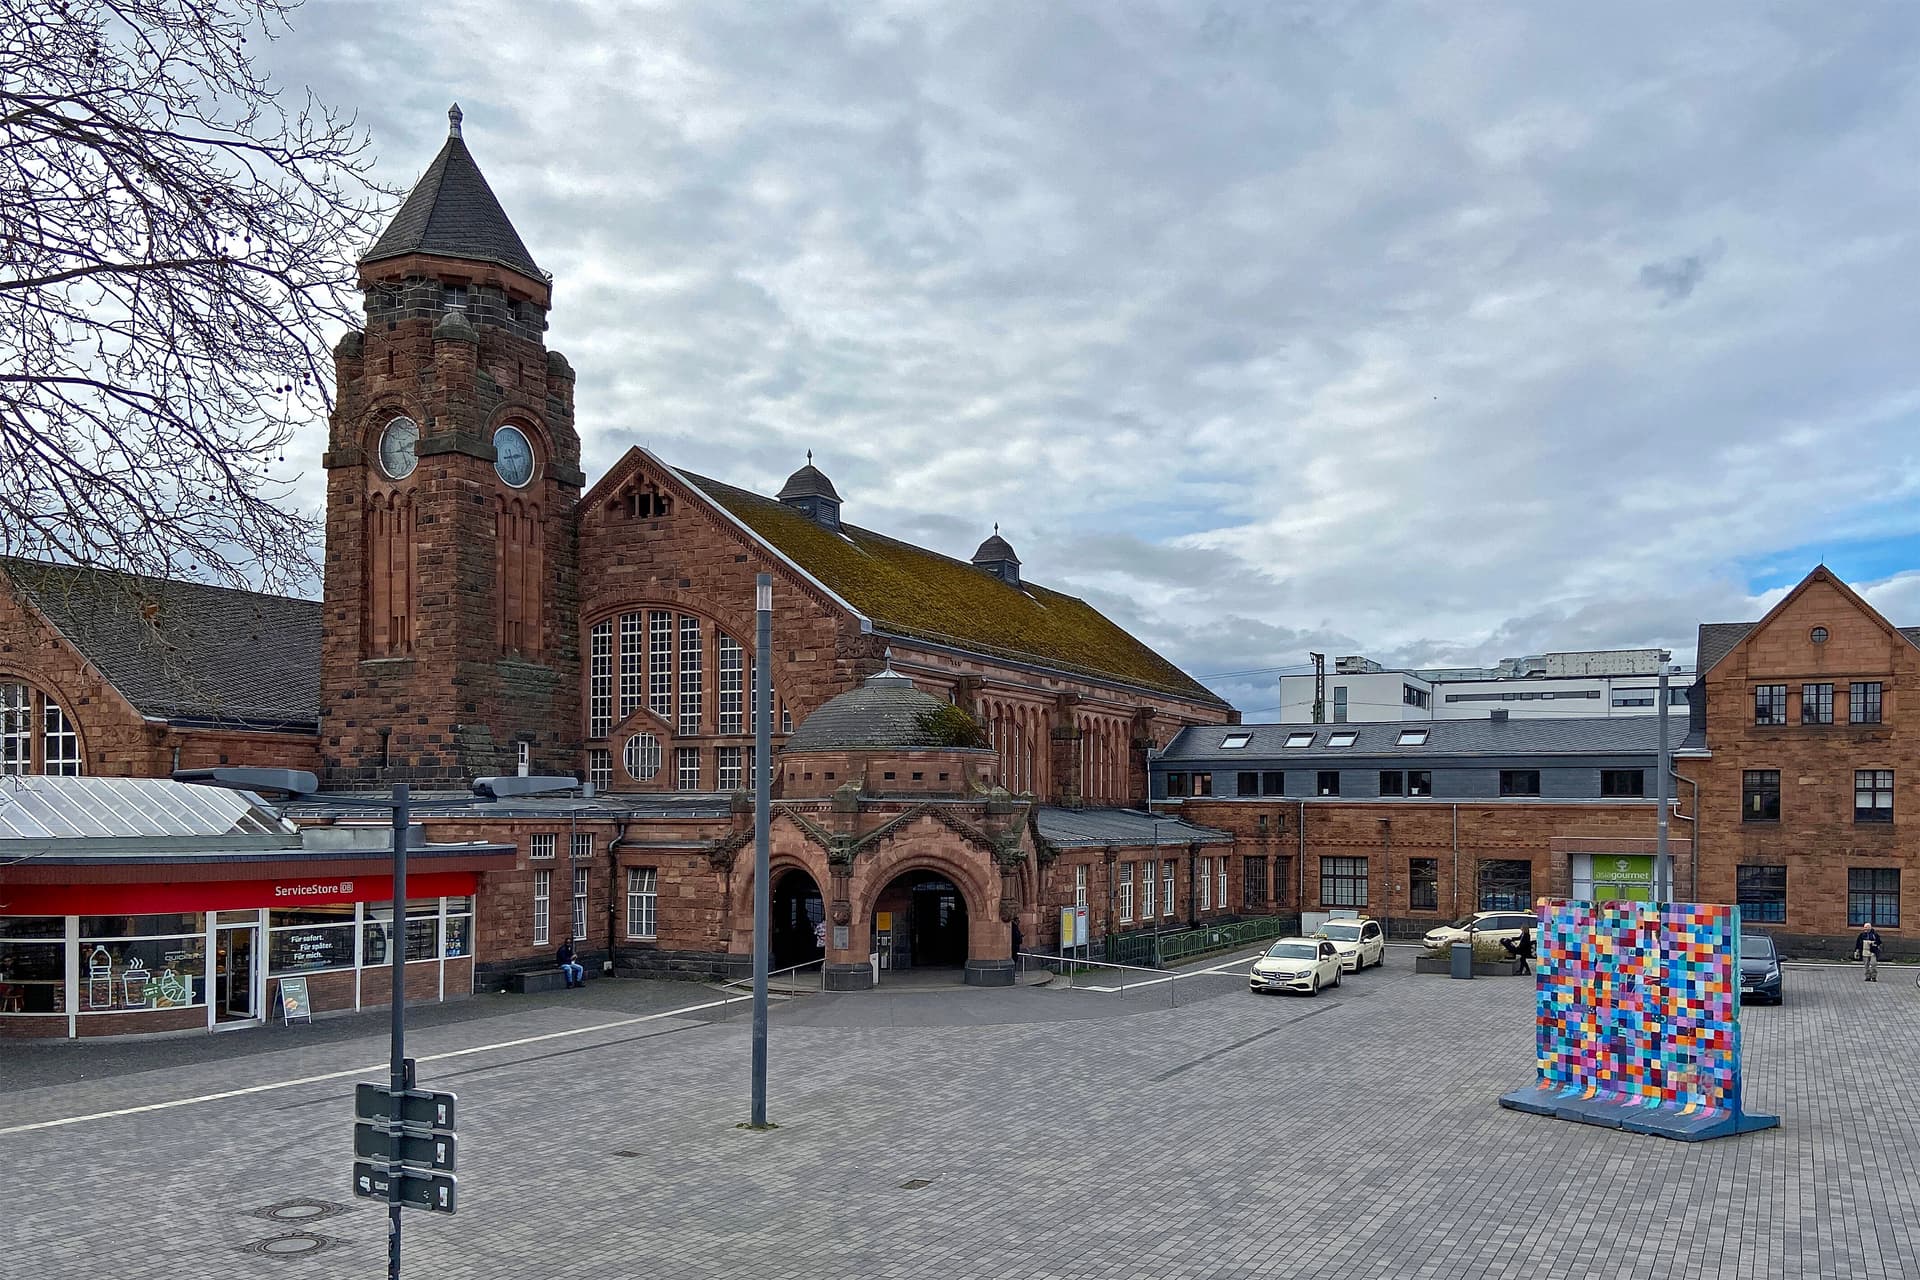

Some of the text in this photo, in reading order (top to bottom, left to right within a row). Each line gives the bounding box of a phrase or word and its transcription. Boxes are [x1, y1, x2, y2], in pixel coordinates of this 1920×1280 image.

[275, 884, 338, 896] ServiceStore
[291, 935, 302, 943] Für
[300, 943, 311, 951] Für
[294, 952, 305, 960] Für
